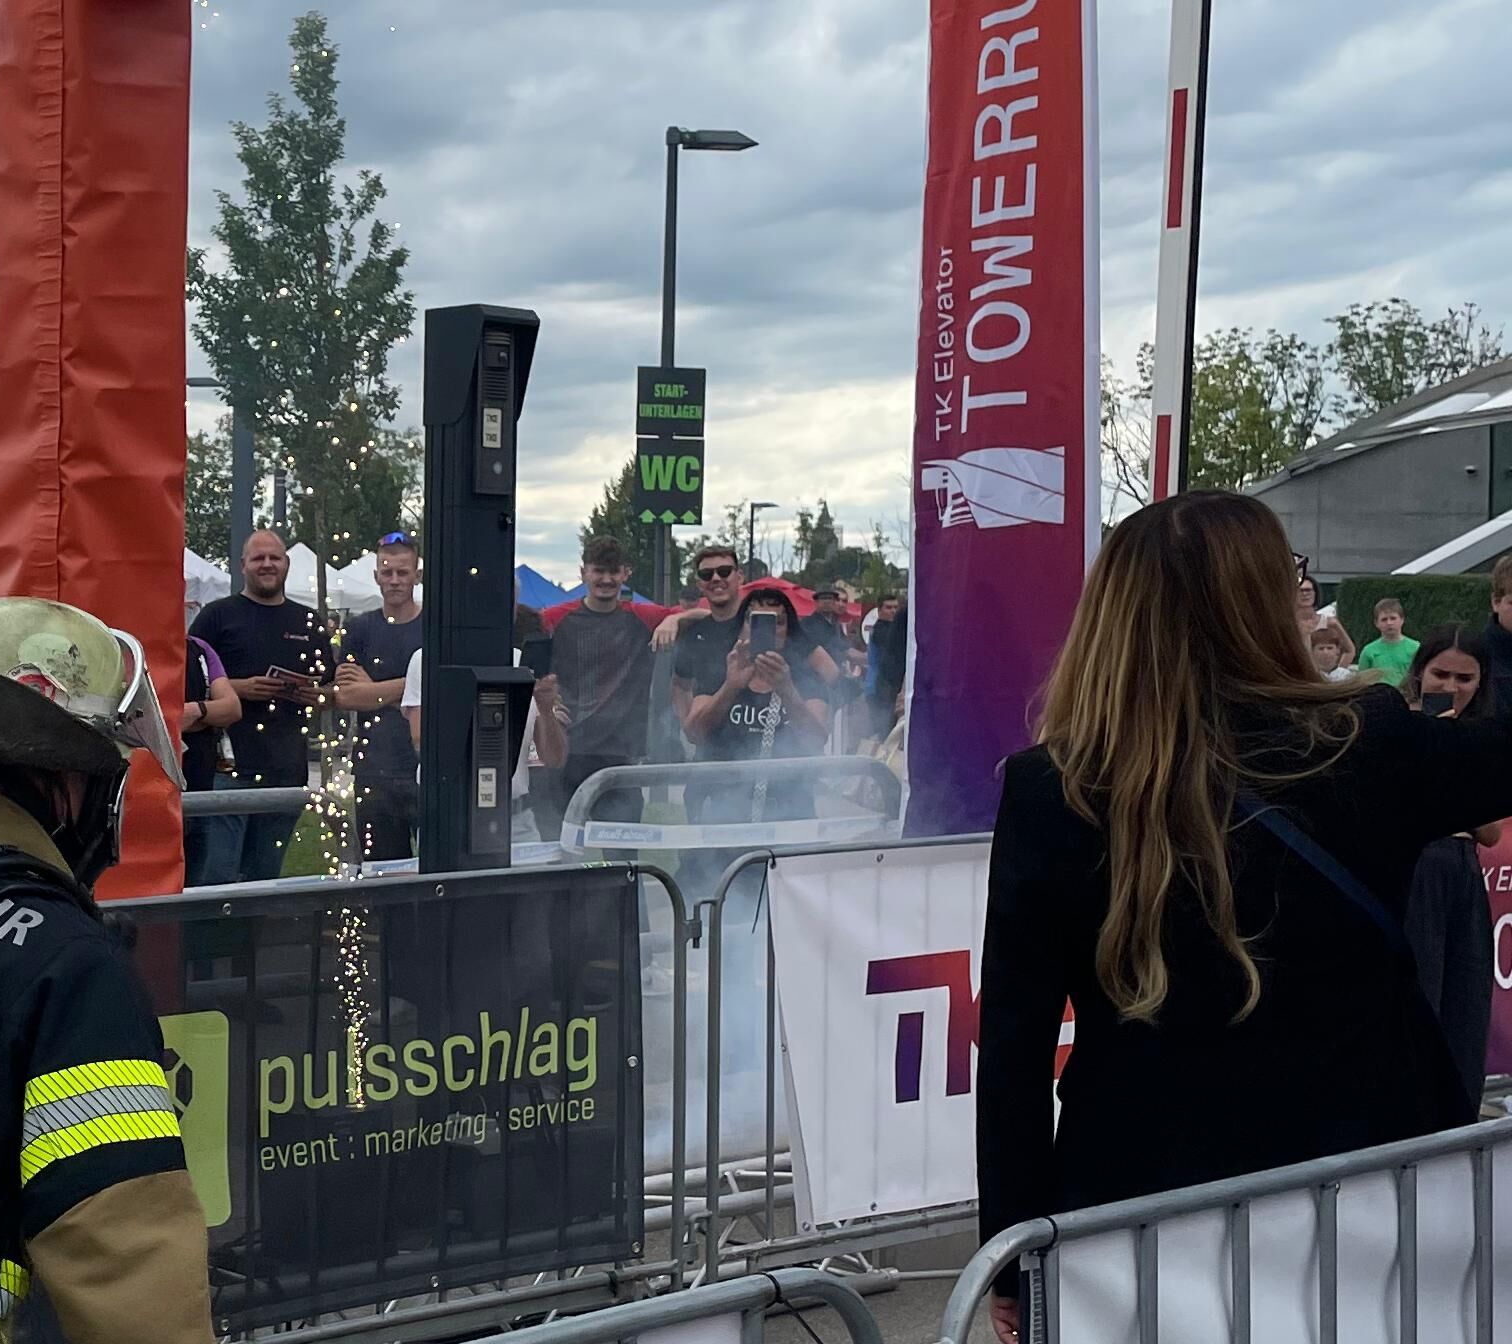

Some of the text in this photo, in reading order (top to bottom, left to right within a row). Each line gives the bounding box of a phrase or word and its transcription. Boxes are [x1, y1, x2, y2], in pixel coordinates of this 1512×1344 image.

[934, 246, 955, 442] TK Elevator
[653, 383, 690, 399] START-
[640, 454, 701, 493] WC
[729, 703, 790, 725] GUE
[259, 1006, 598, 1139] pulsschlag
[260, 1133, 340, 1171] event
[364, 1110, 488, 1157] marketing
[508, 1093, 596, 1132] service
